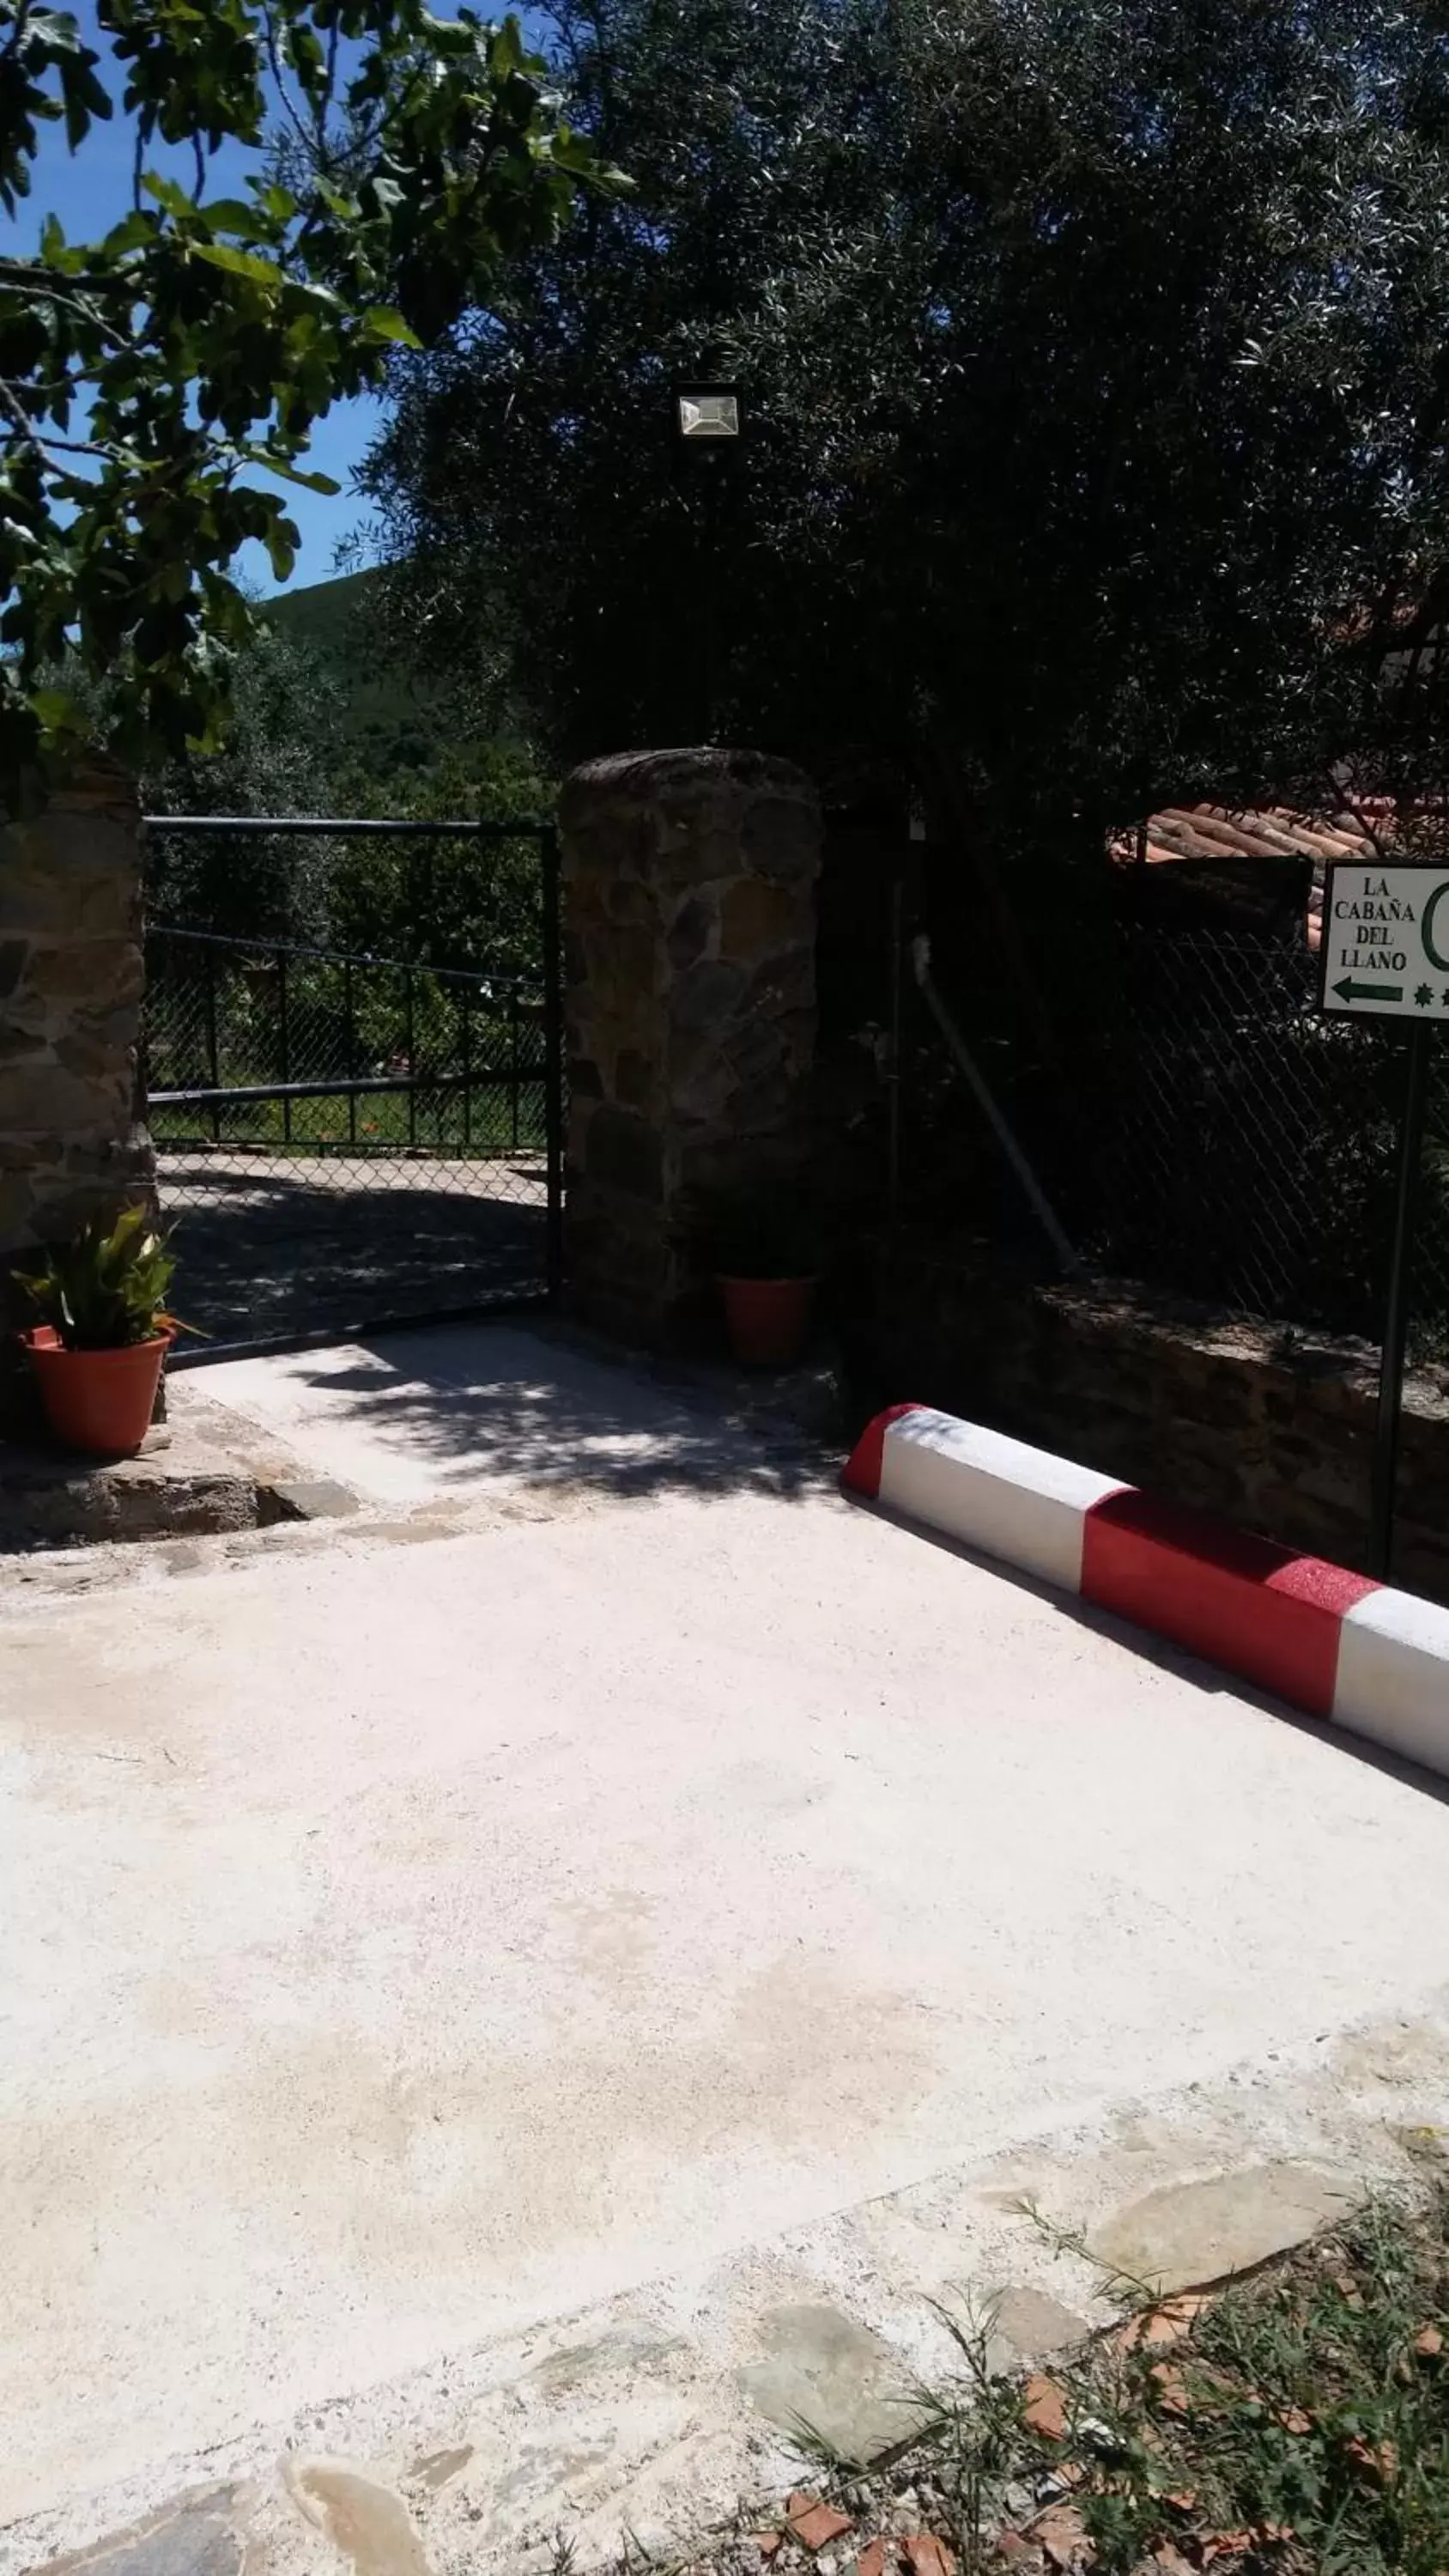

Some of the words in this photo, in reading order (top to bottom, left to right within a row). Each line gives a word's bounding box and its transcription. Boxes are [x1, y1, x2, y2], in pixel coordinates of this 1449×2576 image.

[1363, 878, 1390, 896] LA
[1335, 898, 1416, 921] CABAÑA
[1357, 925, 1394, 945] DEL
[1341, 949, 1407, 971] LLANO
